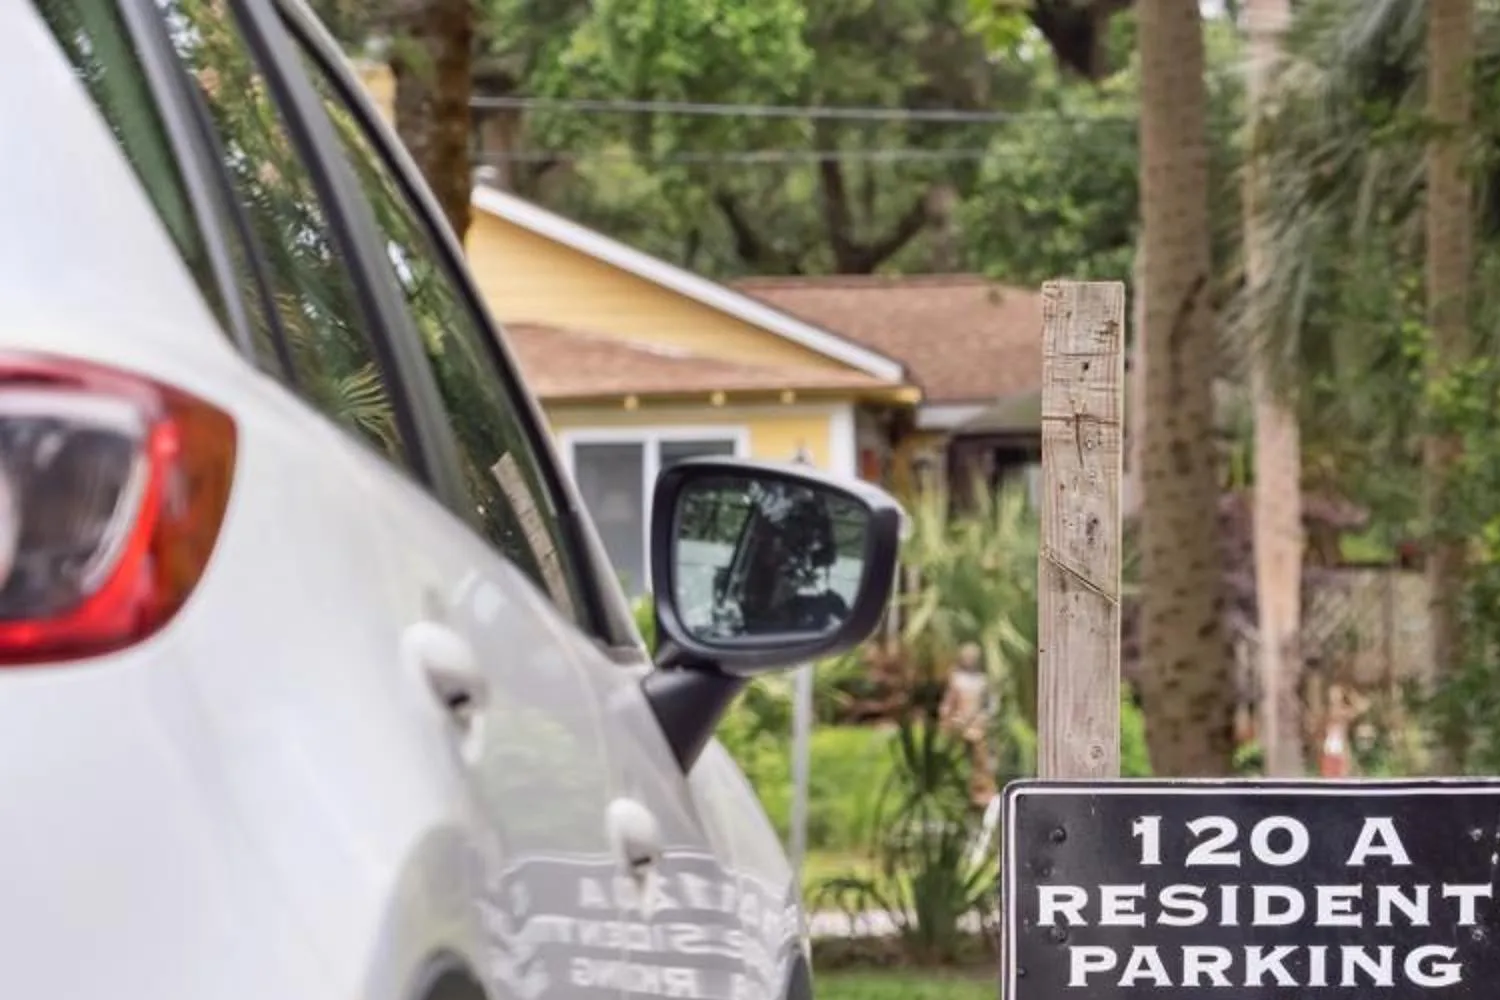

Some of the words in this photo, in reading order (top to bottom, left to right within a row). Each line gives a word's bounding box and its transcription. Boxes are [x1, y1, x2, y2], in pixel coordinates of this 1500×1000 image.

[1132, 815, 1310, 867] 120
[1345, 816, 1413, 866] A
[1035, 882, 1493, 928] RESIDENT
[1067, 945, 1463, 988] PARKING
